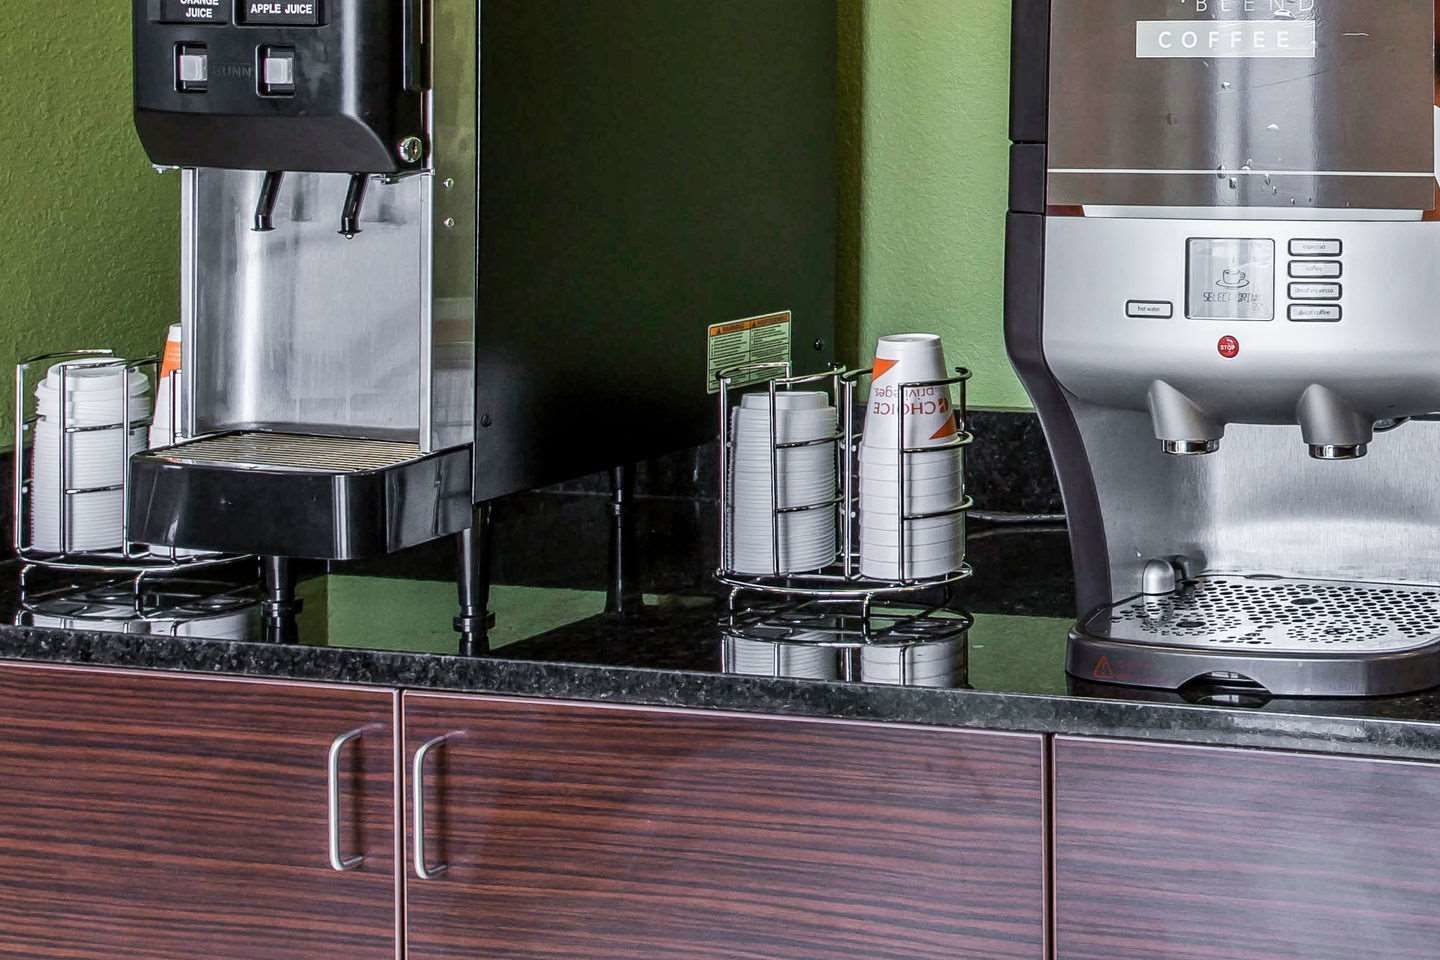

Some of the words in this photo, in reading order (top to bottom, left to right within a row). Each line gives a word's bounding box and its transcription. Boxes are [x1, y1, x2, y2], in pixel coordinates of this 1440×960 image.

[185, 8, 212, 18] JUICE
[250, 3, 281, 14] APPLE
[285, 4, 313, 14] JUICE
[1158, 31, 1289, 49] COFFEE
